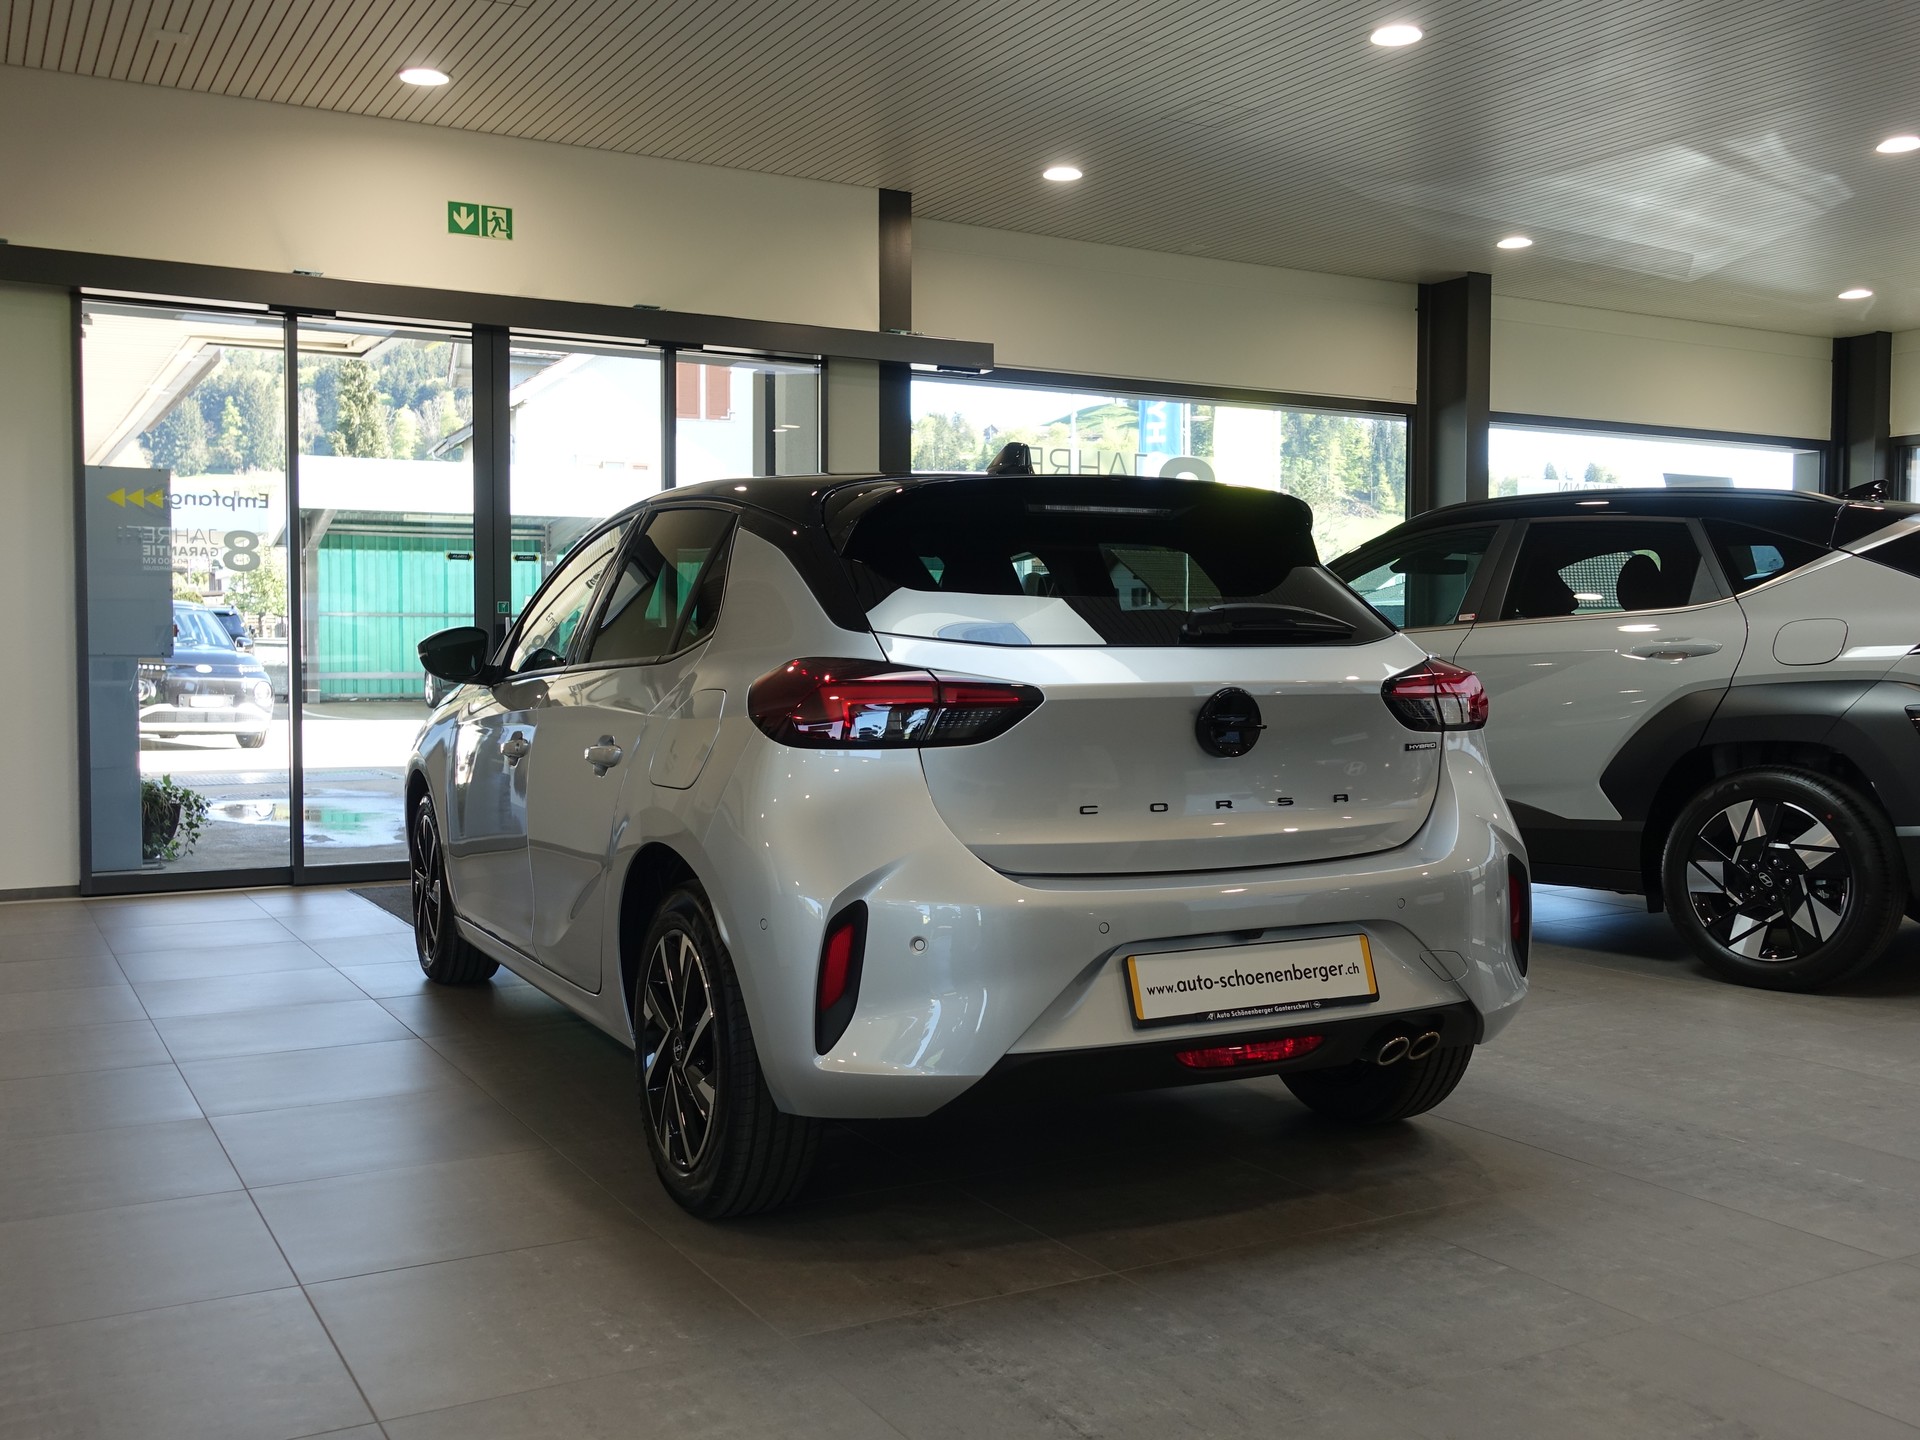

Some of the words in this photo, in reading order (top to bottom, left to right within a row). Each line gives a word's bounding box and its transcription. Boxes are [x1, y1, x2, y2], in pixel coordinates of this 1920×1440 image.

[1408, 742, 1436, 750] HYBRID
[1079, 793, 1349, 815] CORSA
[1146, 963, 1360, 995] www.auto-schoenenberger.ch
[1216, 1011, 1230, 1019] Auto
[1231, 1006, 1274, 1018] Schönenberger
